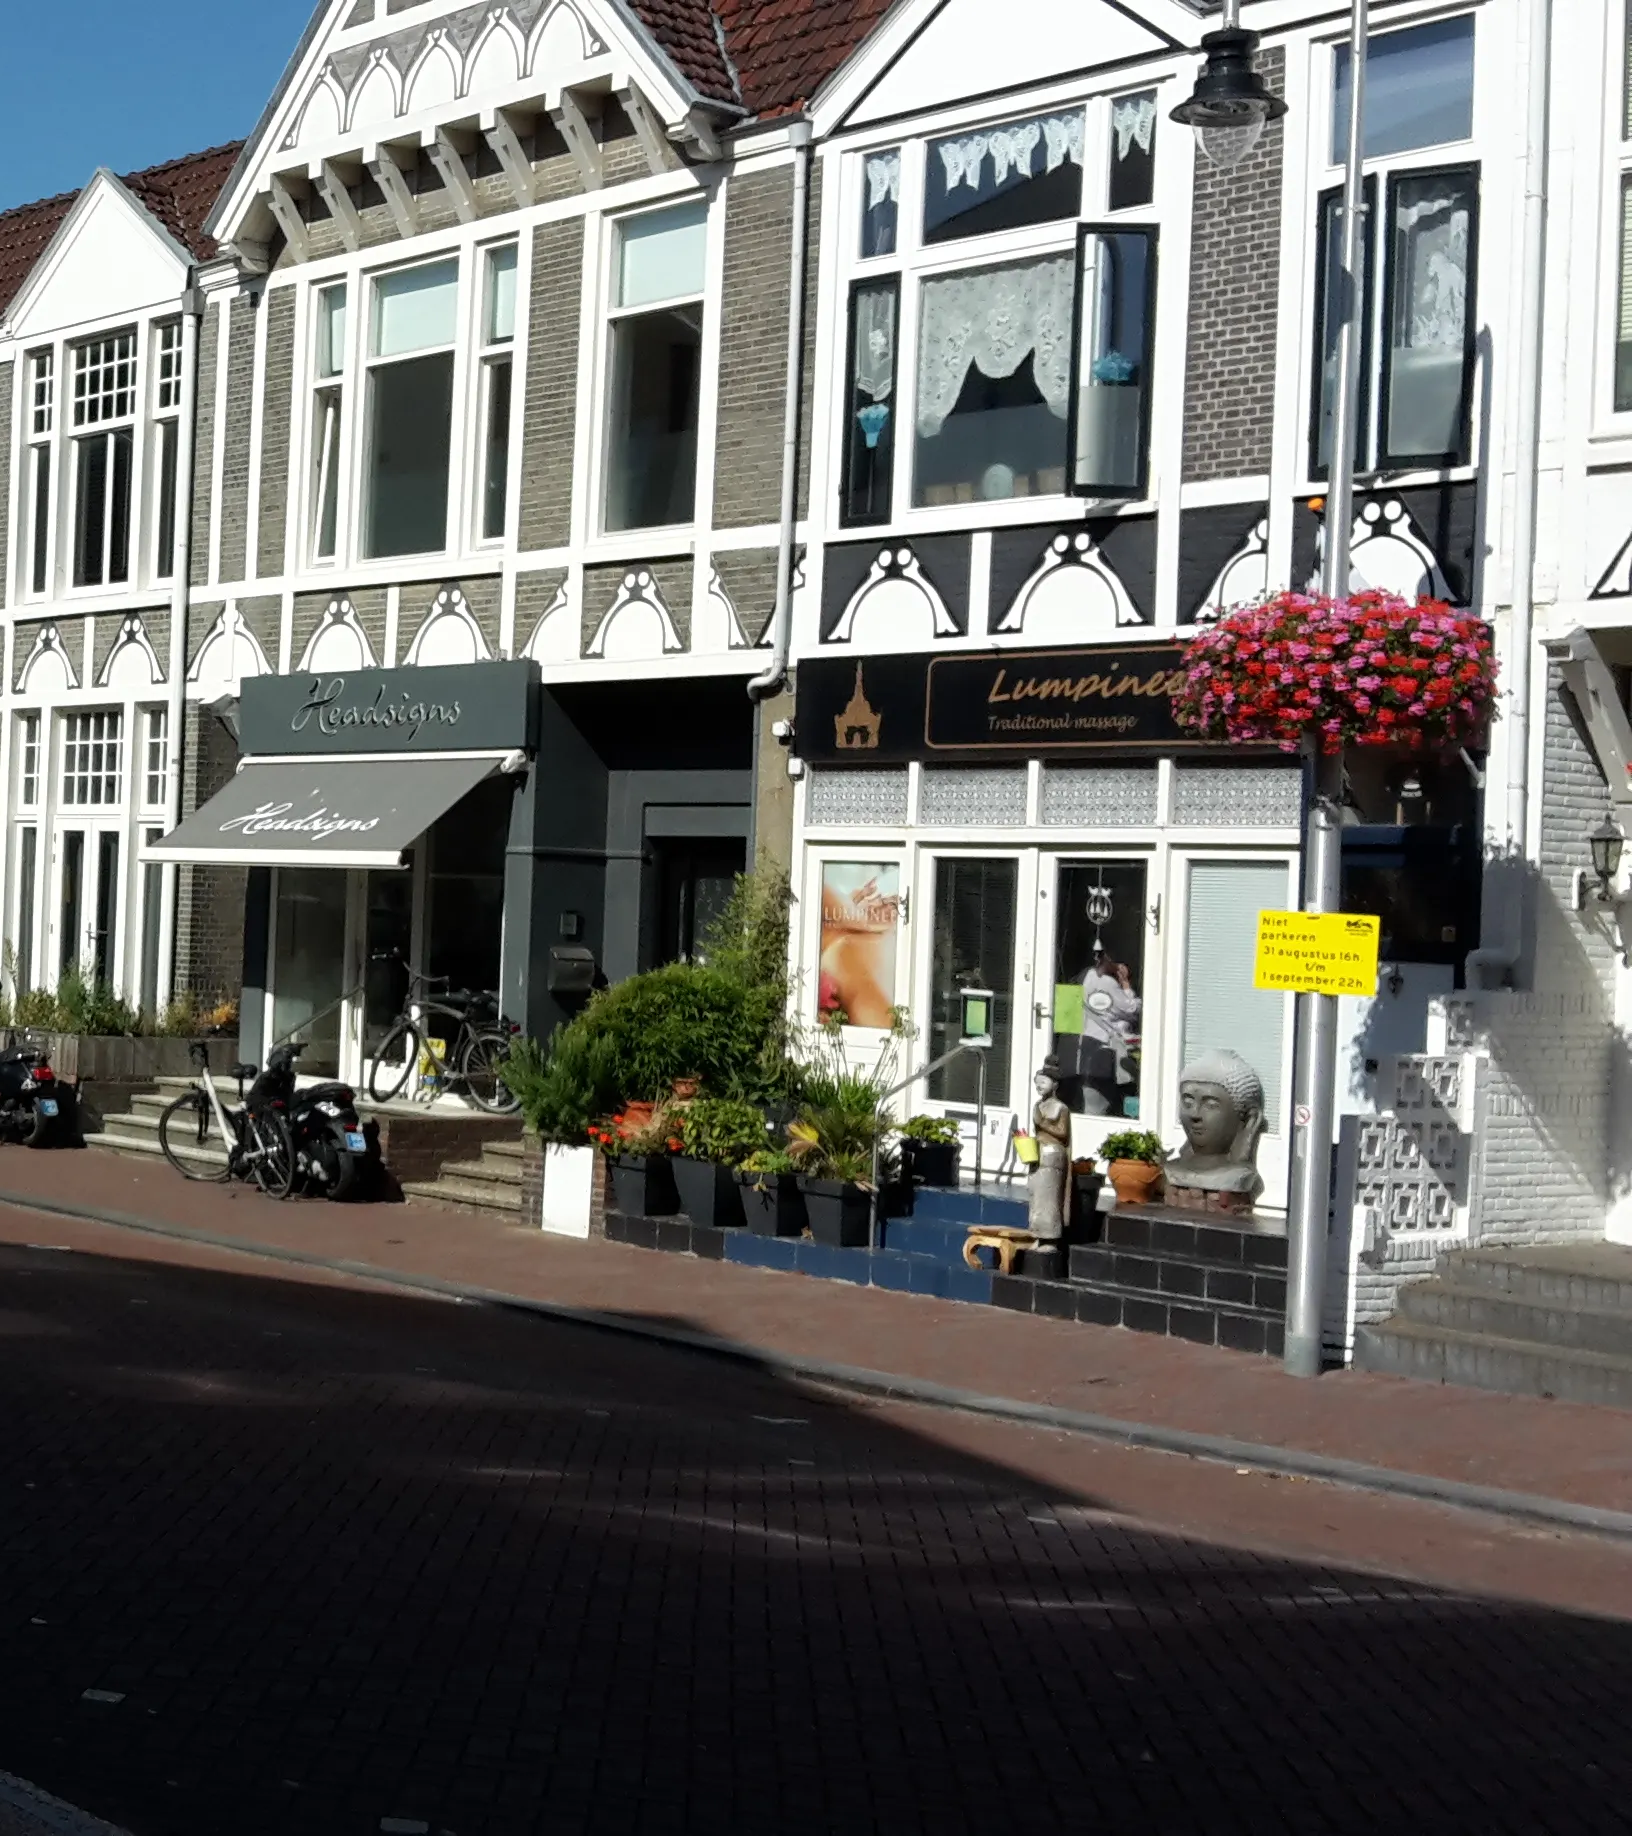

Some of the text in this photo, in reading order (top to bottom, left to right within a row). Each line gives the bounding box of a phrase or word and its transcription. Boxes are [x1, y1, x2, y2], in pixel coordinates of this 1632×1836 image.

[291, 678, 462, 742] Headsigns
[988, 713, 1138, 733] Traditional massage
[219, 801, 380, 841] Headsigns
[1262, 917, 1288, 927] Niet
[1261, 932, 1316, 942] parkeren
[1263, 946, 1275, 955] 31
[1278, 948, 1336, 960] augustus
[1305, 962, 1326, 973] t/m
[1262, 971, 1266, 980] 1
[1269, 973, 1335, 985] september
